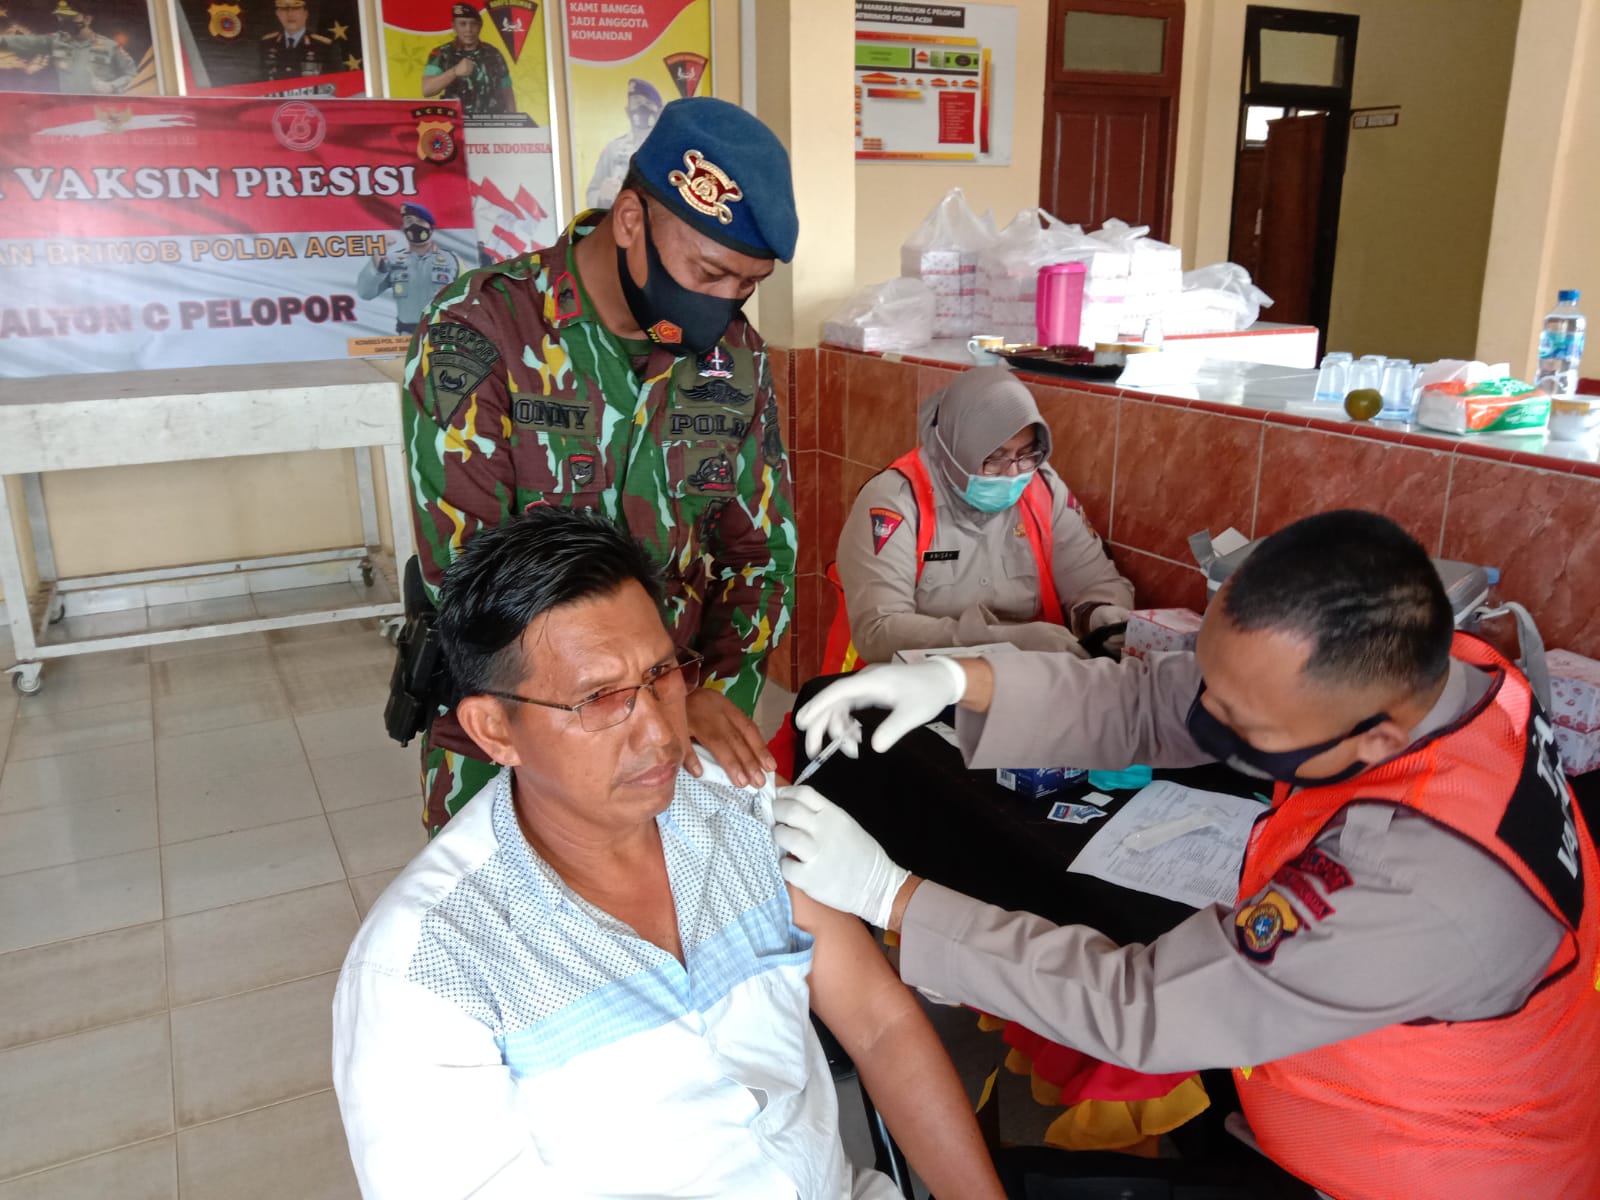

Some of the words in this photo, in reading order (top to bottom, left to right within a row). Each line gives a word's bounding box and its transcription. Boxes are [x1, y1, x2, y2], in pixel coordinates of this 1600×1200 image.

[570, 3, 598, 13] KAMI
[601, 3, 645, 15] BANGGA
[570, 16, 596, 27] JADI
[598, 18, 649, 28] ANGGOTA
[572, 30, 632, 41] KOMANDAN
[415, 107, 455, 117] ACEH
[14, 166, 220, 201] VAKSIN
[231, 164, 419, 198] PRESISI
[47, 240, 181, 266] BRIMOB
[192, 236, 296, 262] POLDA
[304, 234, 387, 259] ACEH
[141, 304, 170, 332] C
[178, 293, 358, 330] PELOPOR
[514, 397, 590, 430] ONNY
